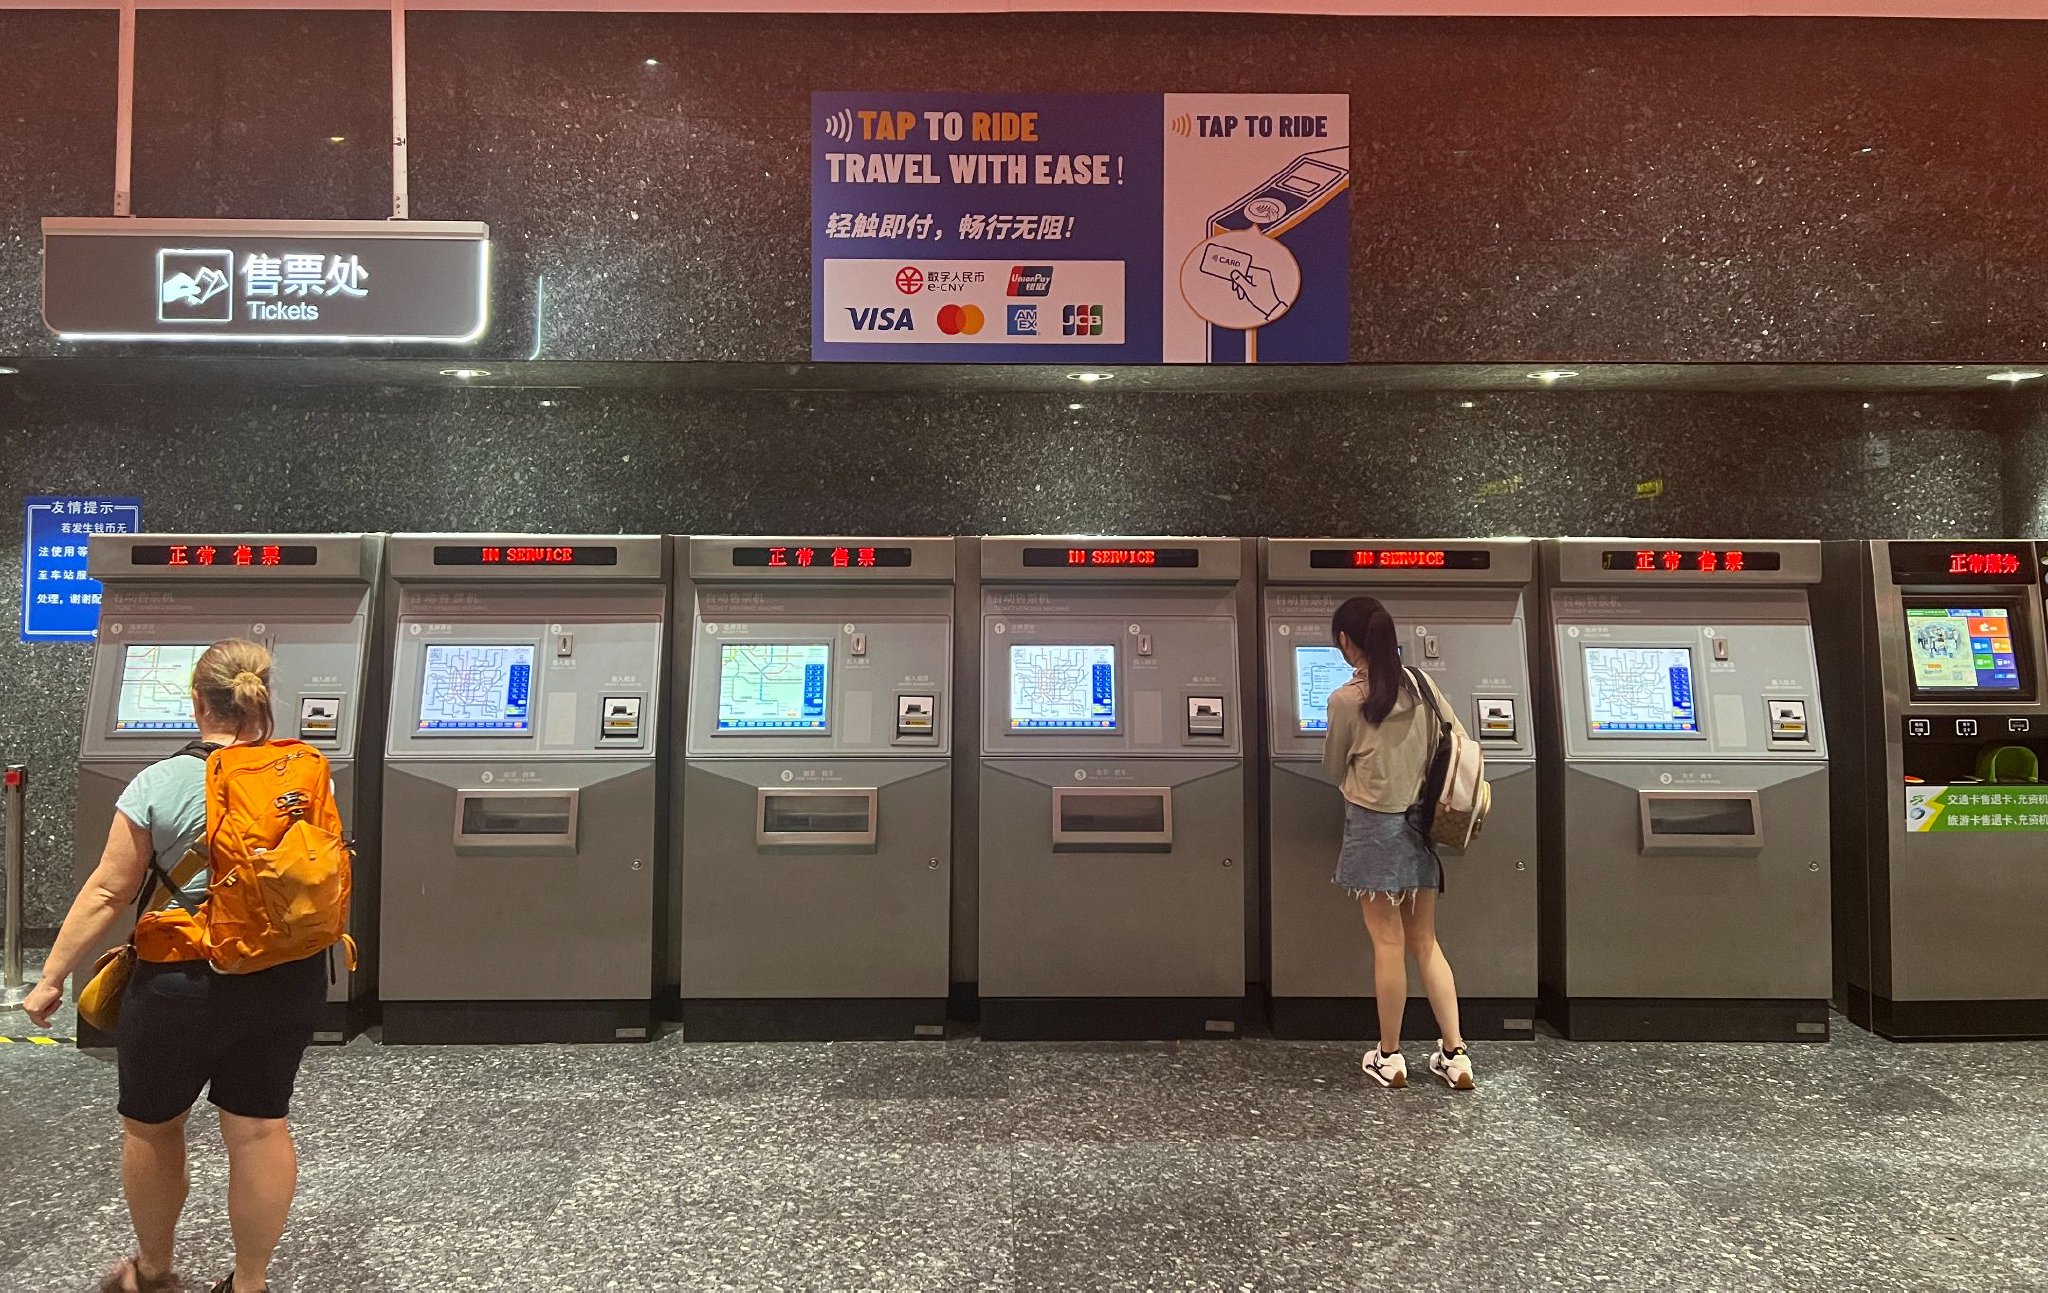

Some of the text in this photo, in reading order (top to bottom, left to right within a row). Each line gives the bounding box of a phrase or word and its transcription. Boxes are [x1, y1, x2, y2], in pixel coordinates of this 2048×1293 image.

[858, 111, 1038, 142] TAP TO RIDE
[1197, 115, 1327, 137] TAP TO RIDE
[825, 153, 940, 184] TRAVEL
[949, 153, 1028, 184] WITH
[1218, 256, 1241, 268] CARD
[242, 252, 370, 298] 售票处
[927, 271, 985, 283] 数字人民币
[1011, 273, 1051, 285] UnionPay
[927, 282, 965, 292] e-CNY
[246, 300, 319, 321] Tickets
[844, 307, 914, 331] VISA
[1062, 315, 1102, 326] JCB
[51, 501, 114, 515] 友情提示
[38, 545, 89, 557] 法使用等
[482, 548, 574, 562] IN SERVICE
[1068, 549, 1156, 565] IN SERVICE
[1356, 551, 1445, 566] IN SERVICE
[37, 570, 94, 581] 至车站服
